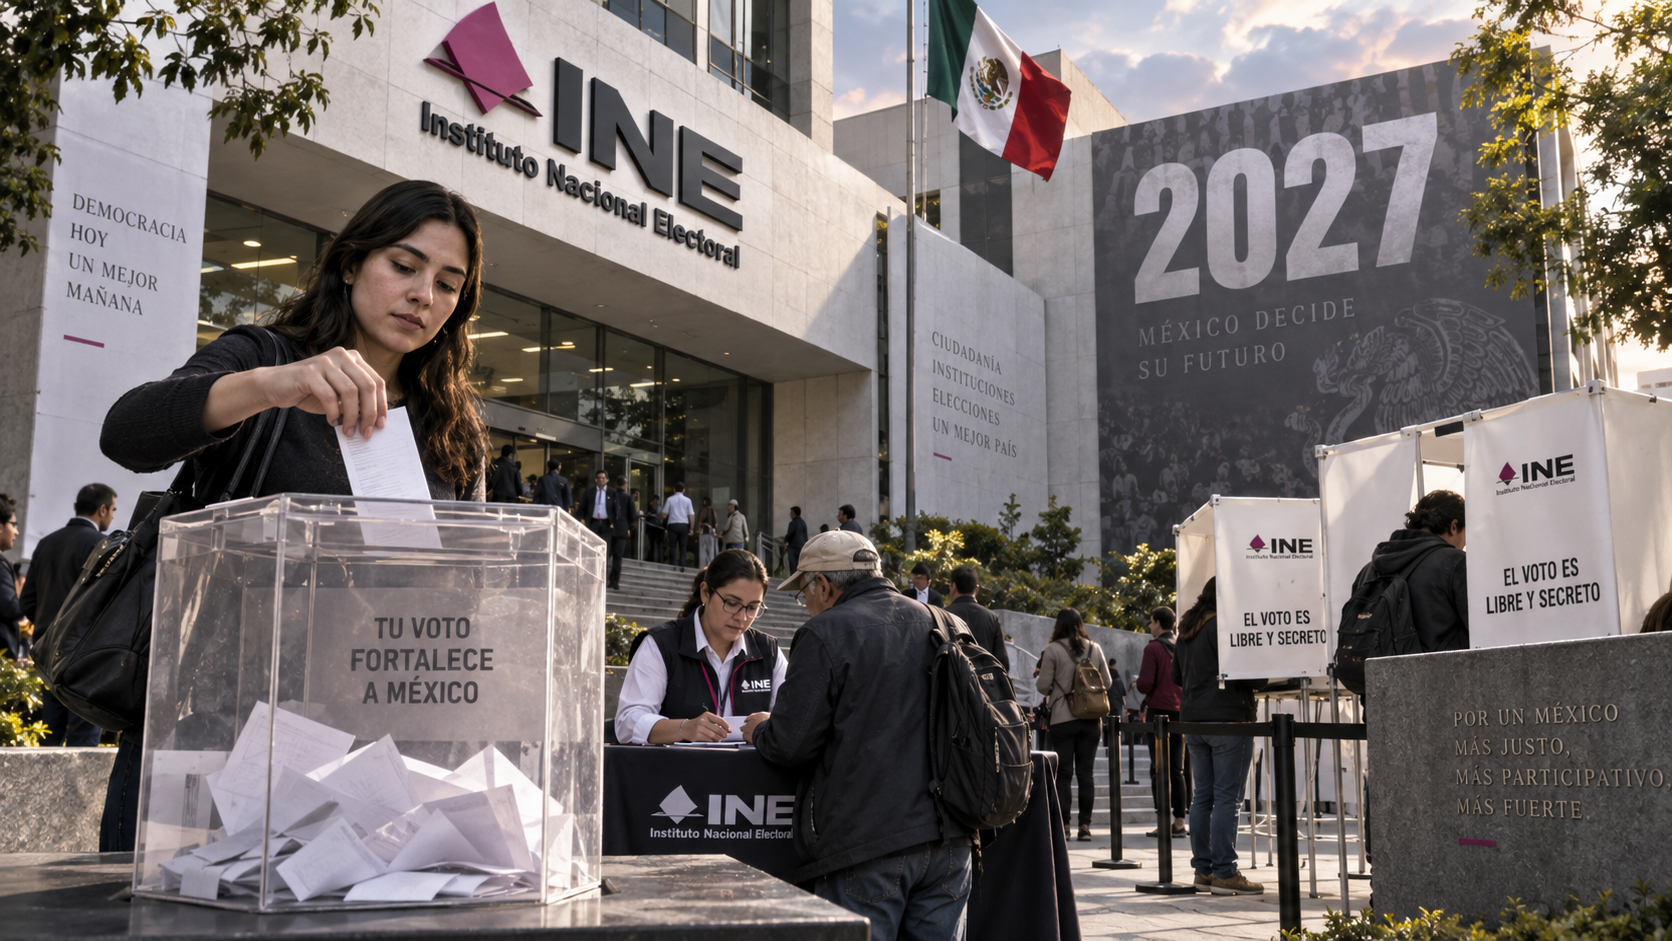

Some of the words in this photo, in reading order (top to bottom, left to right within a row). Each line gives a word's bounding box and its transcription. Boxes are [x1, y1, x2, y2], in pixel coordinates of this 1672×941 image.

[553, 57, 743, 231] INE
[421, 100, 539, 178] Instituto
[547, 158, 647, 227] Nacional
[653, 207, 740, 269] Electoral
[72, 193, 187, 244] DEMOCRACIA
[1134, 111, 1438, 304] 2027
[70, 222, 108, 248] HOY
[69, 252, 94, 274] UN
[101, 261, 158, 292] MEJOR
[66, 281, 143, 316] MAÑANA
[1138, 314, 1239, 347] MÉXICO
[1255, 298, 1355, 330] DECIDE
[931, 331, 1002, 375] CIUDADANÍA
[1138, 358, 1168, 379] SU
[1183, 342, 1286, 374] FUTURO
[932, 359, 1015, 406] INSTITUCIONES
[932, 387, 1000, 426] ELECCIONES
[932, 416, 949, 435] UN
[954, 424, 990, 450] MEJOR
[994, 438, 1017, 458] PAÍS
[1522, 454, 1575, 483] INE
[1271, 538, 1313, 553] INE
[1503, 567, 1519, 586] EL
[1522, 561, 1557, 583] VOTO
[1562, 557, 1579, 578] ES
[1486, 593, 1523, 614] LIBRE
[1527, 591, 1535, 609] Y
[1539, 582, 1601, 608] SECRETO
[374, 617, 404, 639] TU
[411, 617, 470, 639] VOTO
[1244, 612, 1258, 627] EL
[1260, 611, 1292, 626] VOTO
[1296, 610, 1311, 625] ES
[1230, 632, 1263, 648] LIBRE
[1266, 631, 1274, 646] Y
[1278, 629, 1327, 645] SECRETO
[351, 648, 494, 672] FORTALECE
[362, 681, 379, 704] A
[387, 675, 479, 704] MÉXICO
[751, 679, 771, 689] INE
[1454, 710, 1489, 727] POR
[1498, 708, 1525, 726] UN
[1535, 702, 1619, 725] MÉXICO
[1455, 736, 1492, 756] MÁS
[1500, 738, 1571, 759] JUSTO,
[1456, 766, 1493, 786] MÁS
[1502, 768, 1671, 789] PARTICIPATIVO,
[708, 794, 795, 825] INE
[1457, 795, 1494, 816] MÁS
[1504, 799, 1590, 821] FUERTE.
[650, 828, 699, 839] Instituto
[704, 828, 752, 839] Nacional
[755, 828, 793, 839] Electoral
